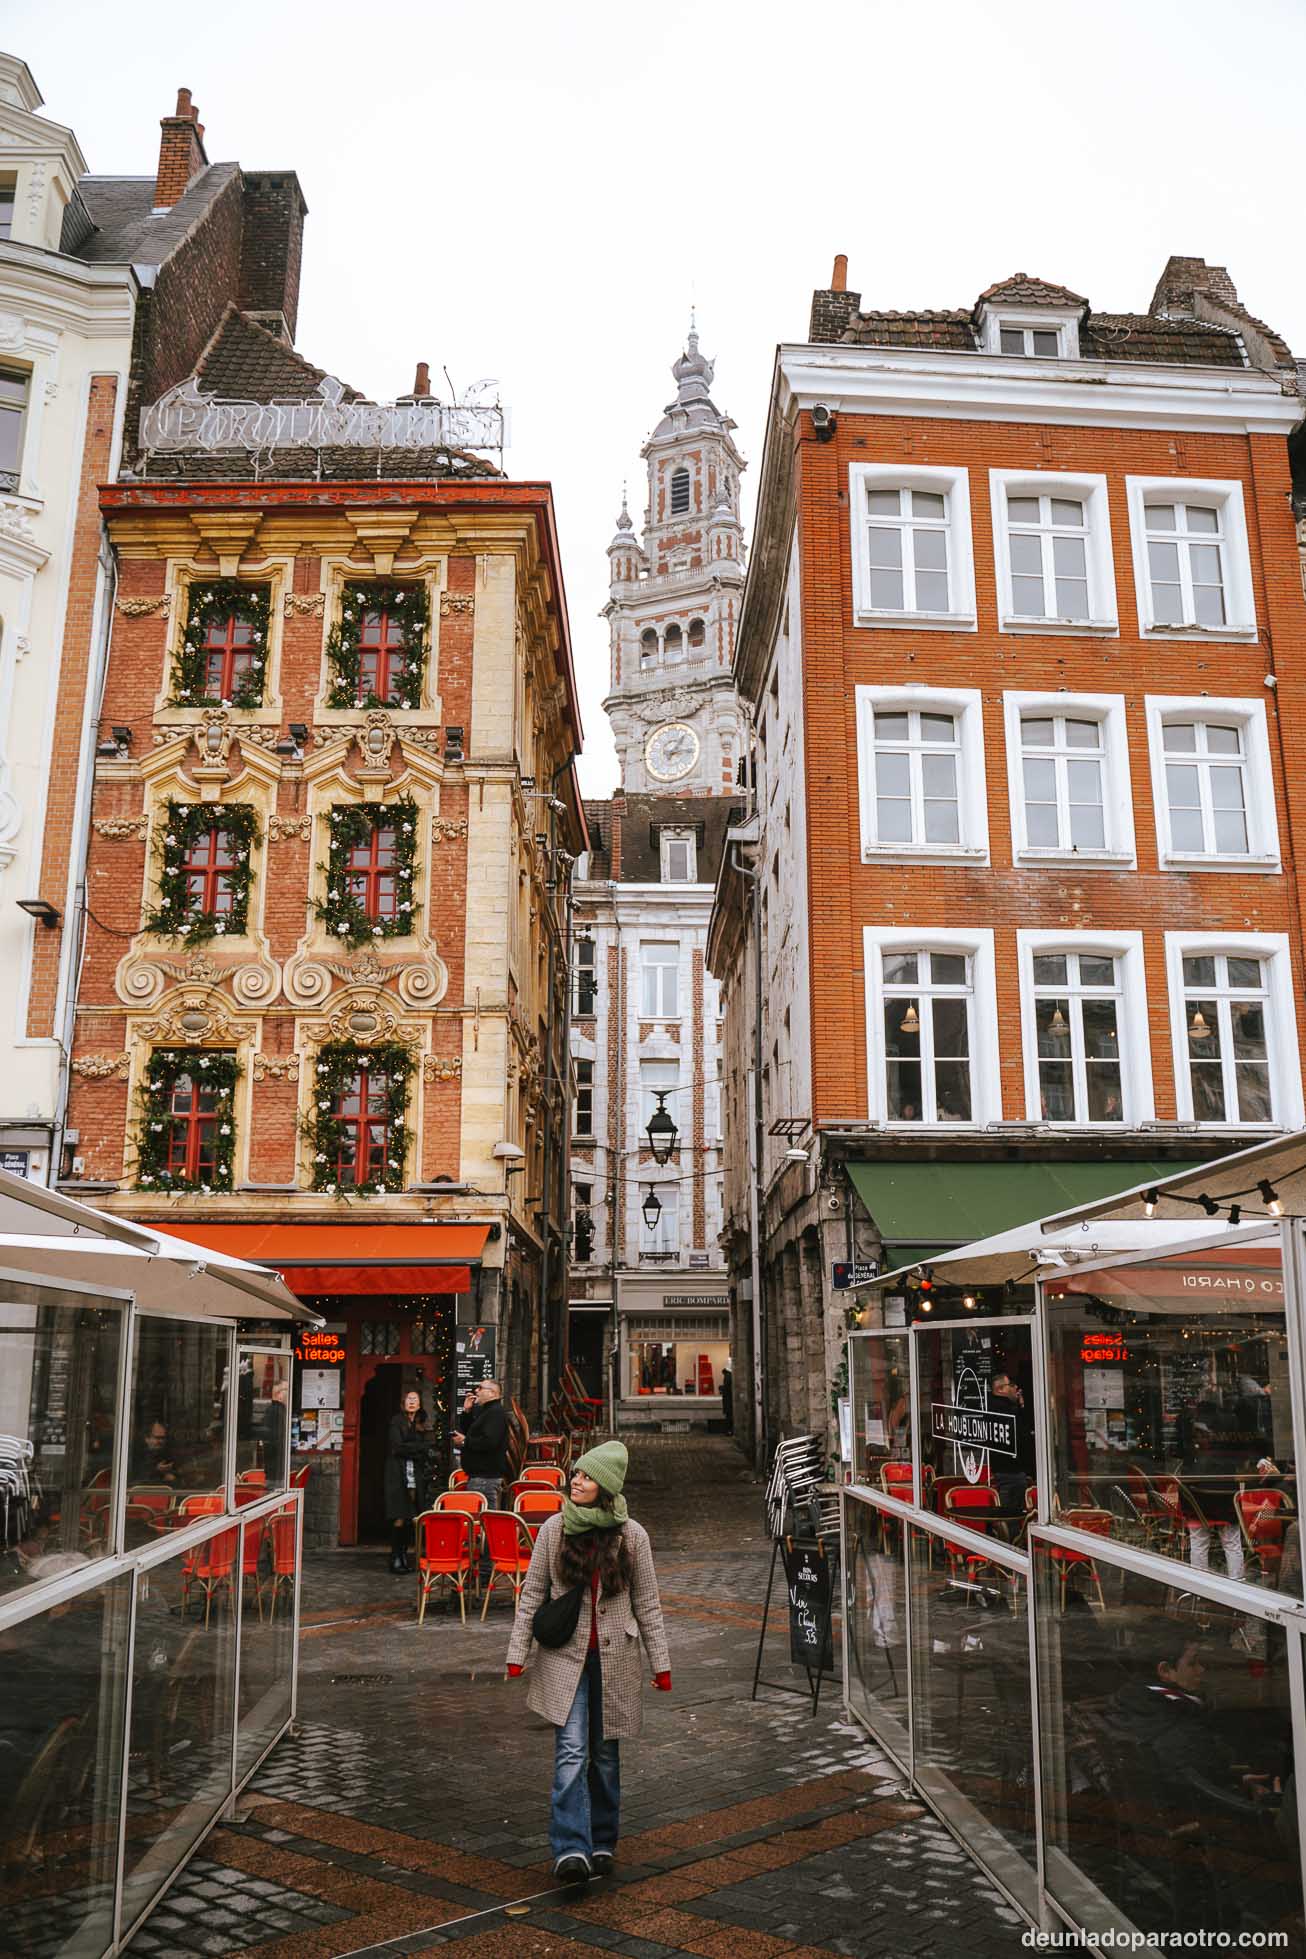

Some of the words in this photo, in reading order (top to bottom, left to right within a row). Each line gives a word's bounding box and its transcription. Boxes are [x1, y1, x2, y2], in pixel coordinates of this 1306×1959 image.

[301, 1331, 339, 1346] Salles
[935, 1412, 945, 1430] LA
[948, 1416, 1011, 1445] HOUBLONNIERE
